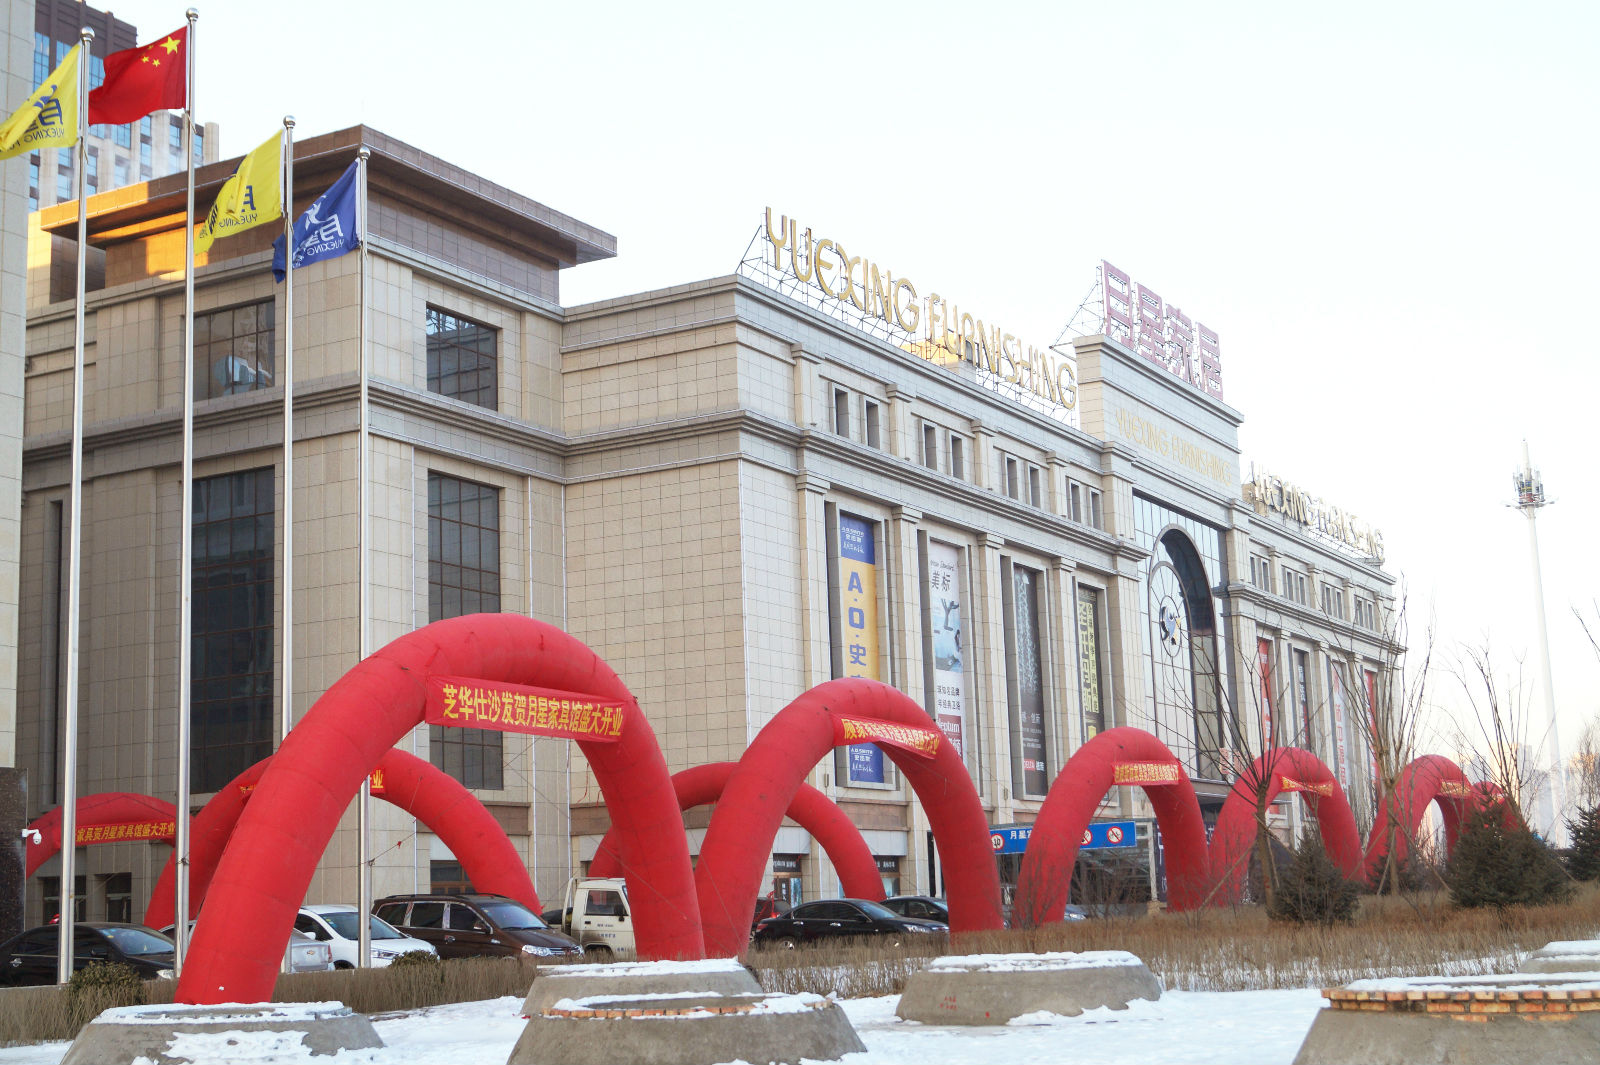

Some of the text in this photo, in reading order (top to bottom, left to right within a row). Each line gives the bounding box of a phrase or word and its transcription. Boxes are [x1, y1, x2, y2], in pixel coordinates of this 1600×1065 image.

[766, 206, 1077, 410] YUEXING FURNISHING
[1101, 258, 1223, 401] 月星家居
[1115, 407, 1232, 486] YUEXING FURNISHING
[442, 683, 624, 737] 芝华仕沙发贺月星家具馆盛大开业
